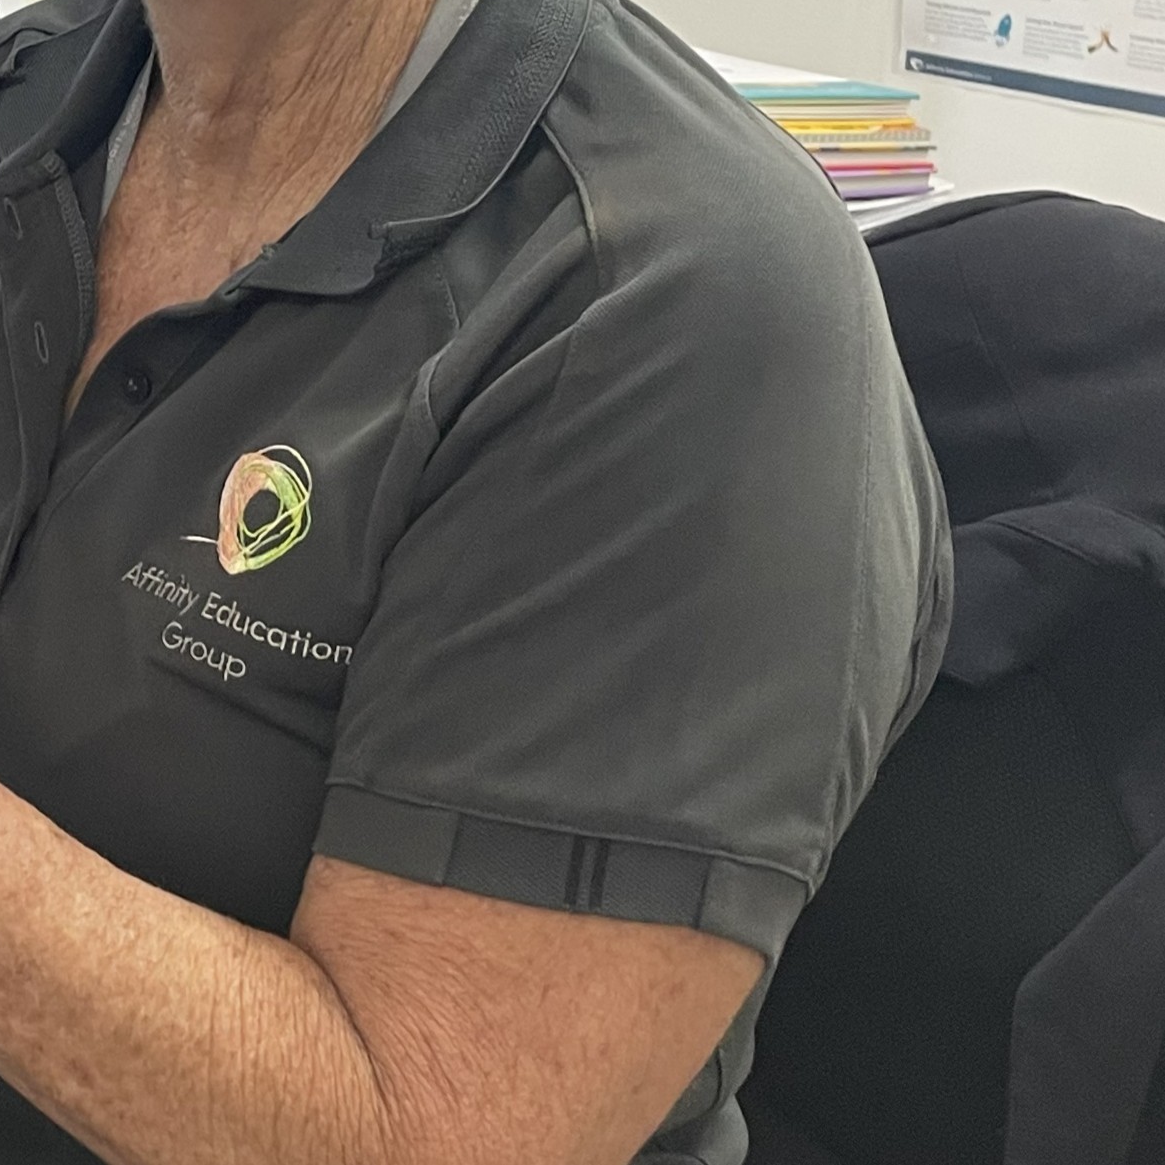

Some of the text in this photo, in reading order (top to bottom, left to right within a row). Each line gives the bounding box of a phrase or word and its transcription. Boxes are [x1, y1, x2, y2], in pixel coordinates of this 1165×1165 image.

[121, 561, 353, 666] Affinity Education
[161, 621, 246, 681] Group
